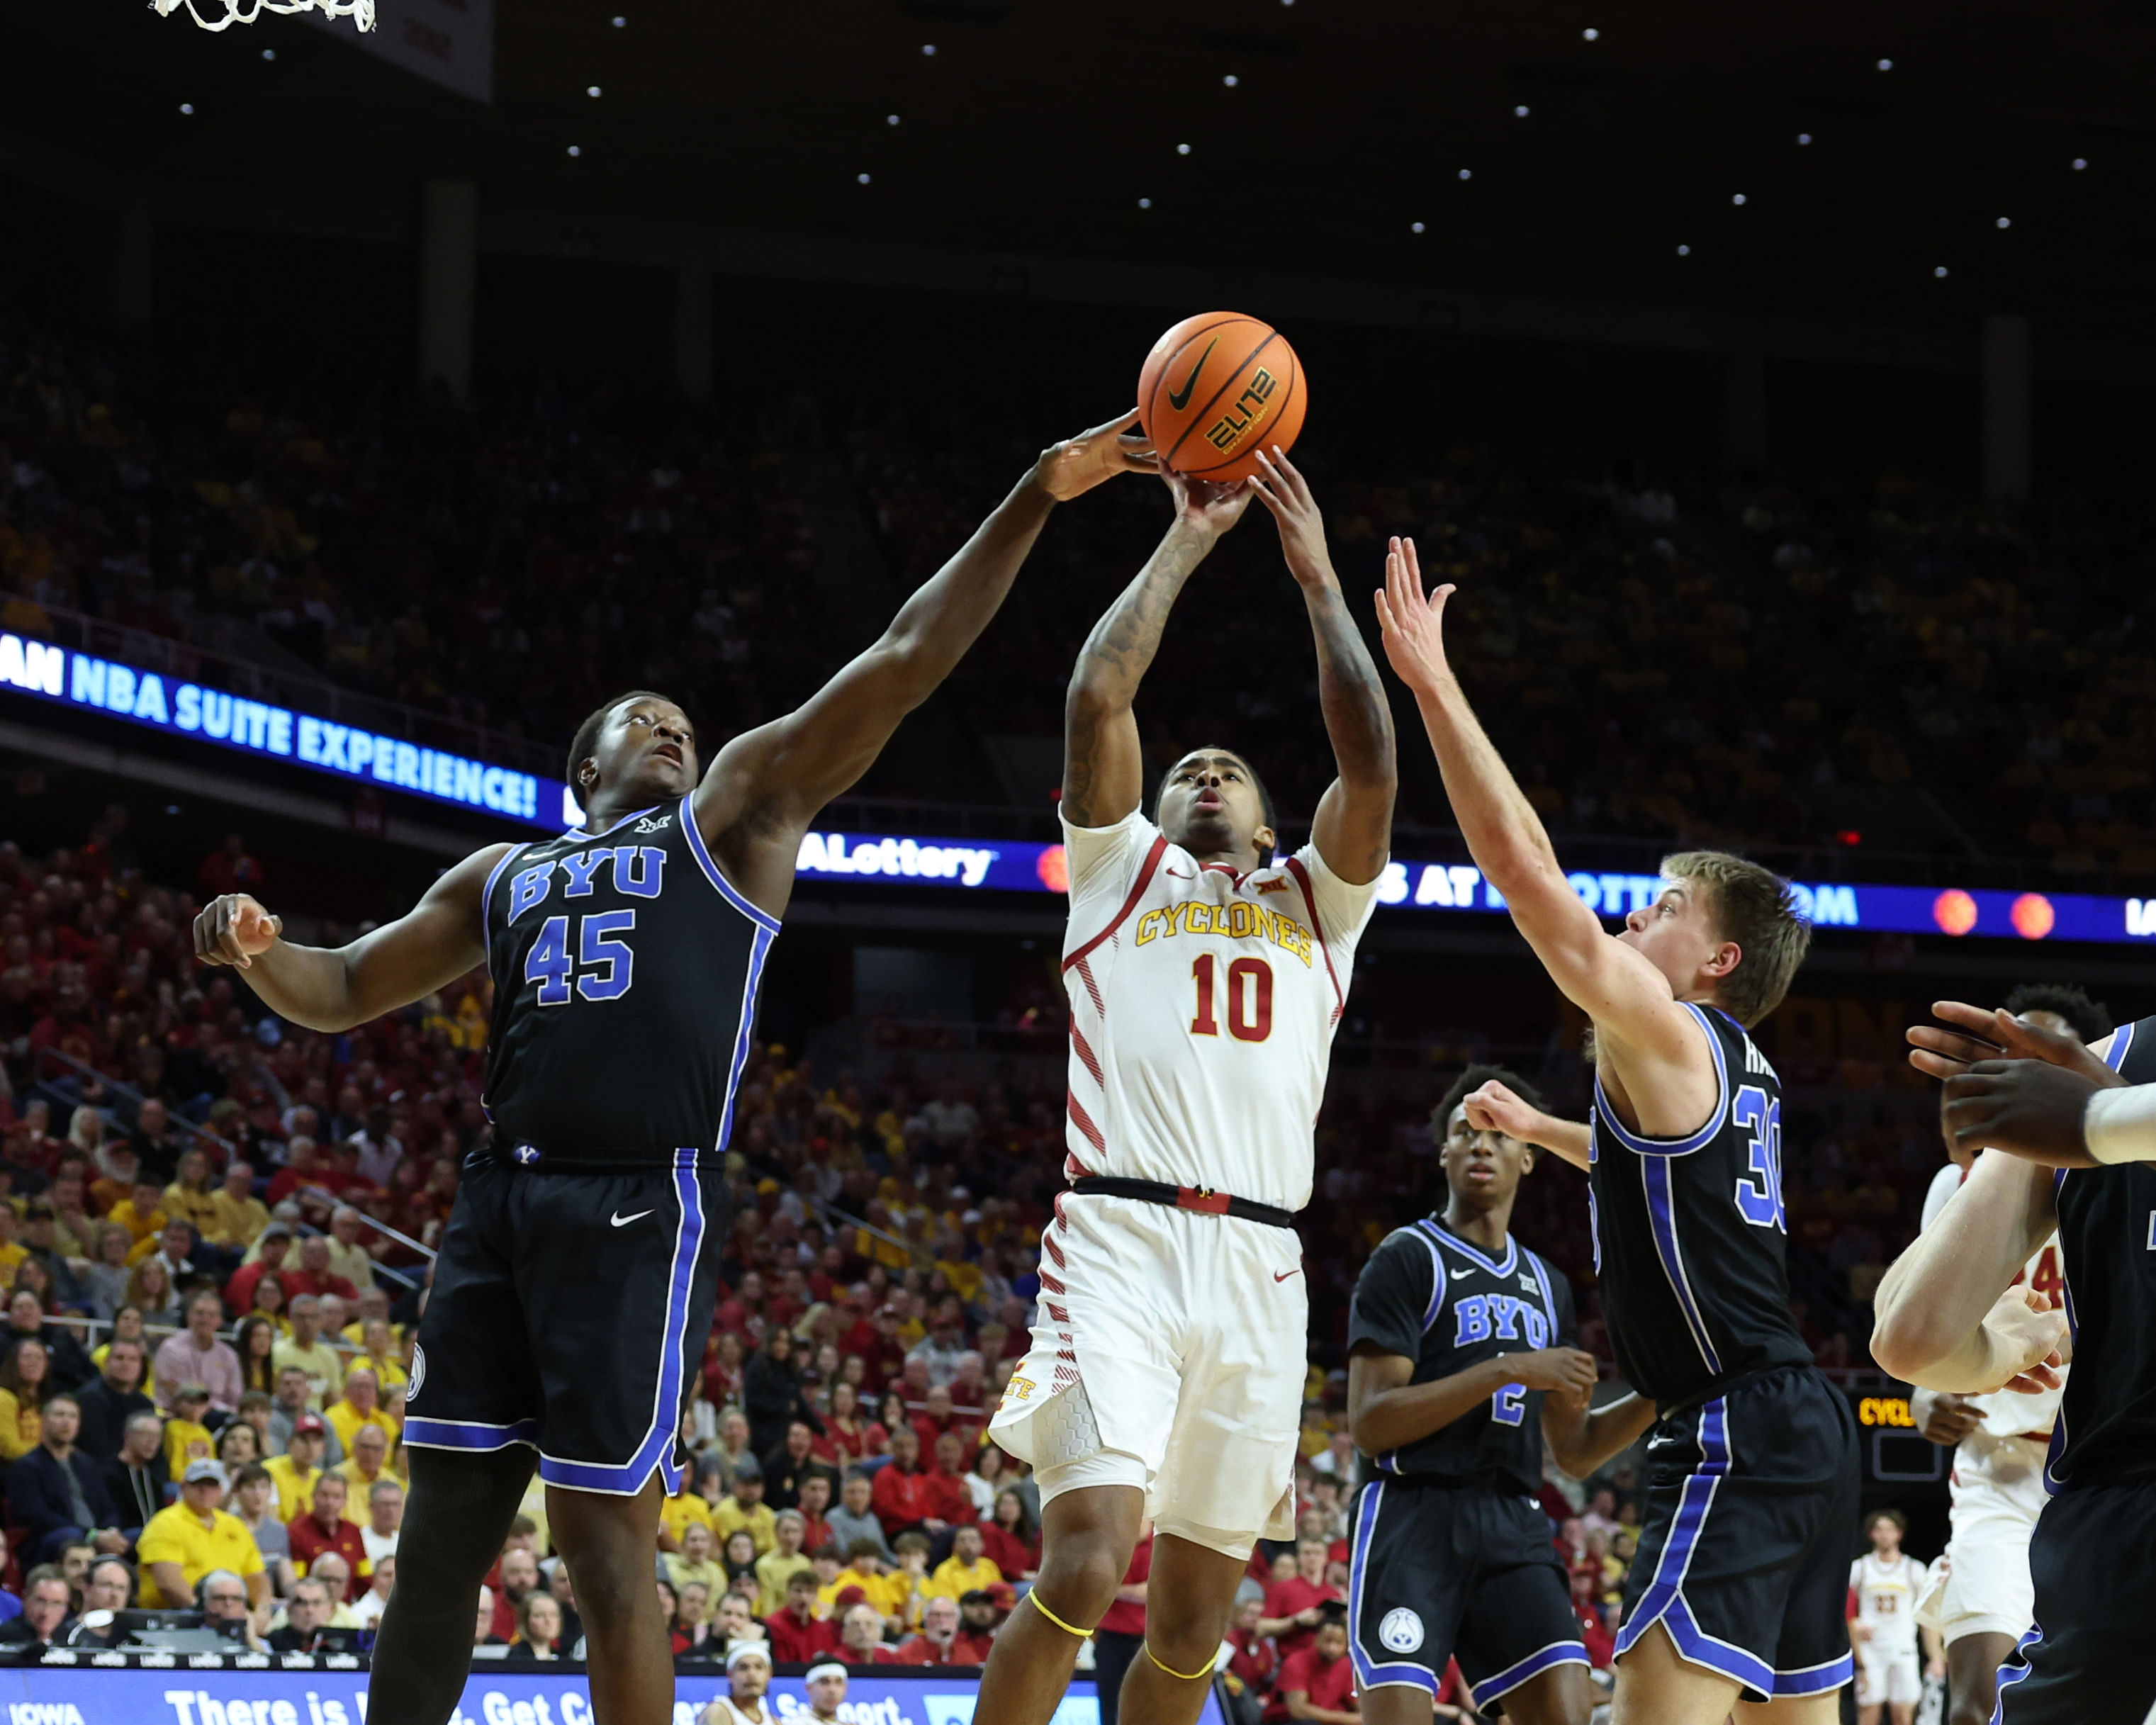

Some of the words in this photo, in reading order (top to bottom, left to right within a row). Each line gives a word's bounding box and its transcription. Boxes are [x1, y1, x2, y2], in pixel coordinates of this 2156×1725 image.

[1204, 366, 1278, 451] ELITE
[0, 633, 64, 696] AN
[71, 652, 169, 726] NBA
[174, 683, 292, 757] SUITE
[297, 714, 537, 819] EXPERIENCE!
[508, 845, 667, 927] BYU
[1415, 865, 1480, 906] AT
[524, 909, 635, 1006] 45
[1135, 900, 1312, 969] CYCLONES
[1190, 953, 1274, 1043] 10
[1454, 1293, 1548, 1349] BYU
[8, 1703, 86, 1725] IOWA
[164, 1690, 298, 1725] There
[305, 1691, 349, 1725] is
[483, 1691, 554, 1725] Get
